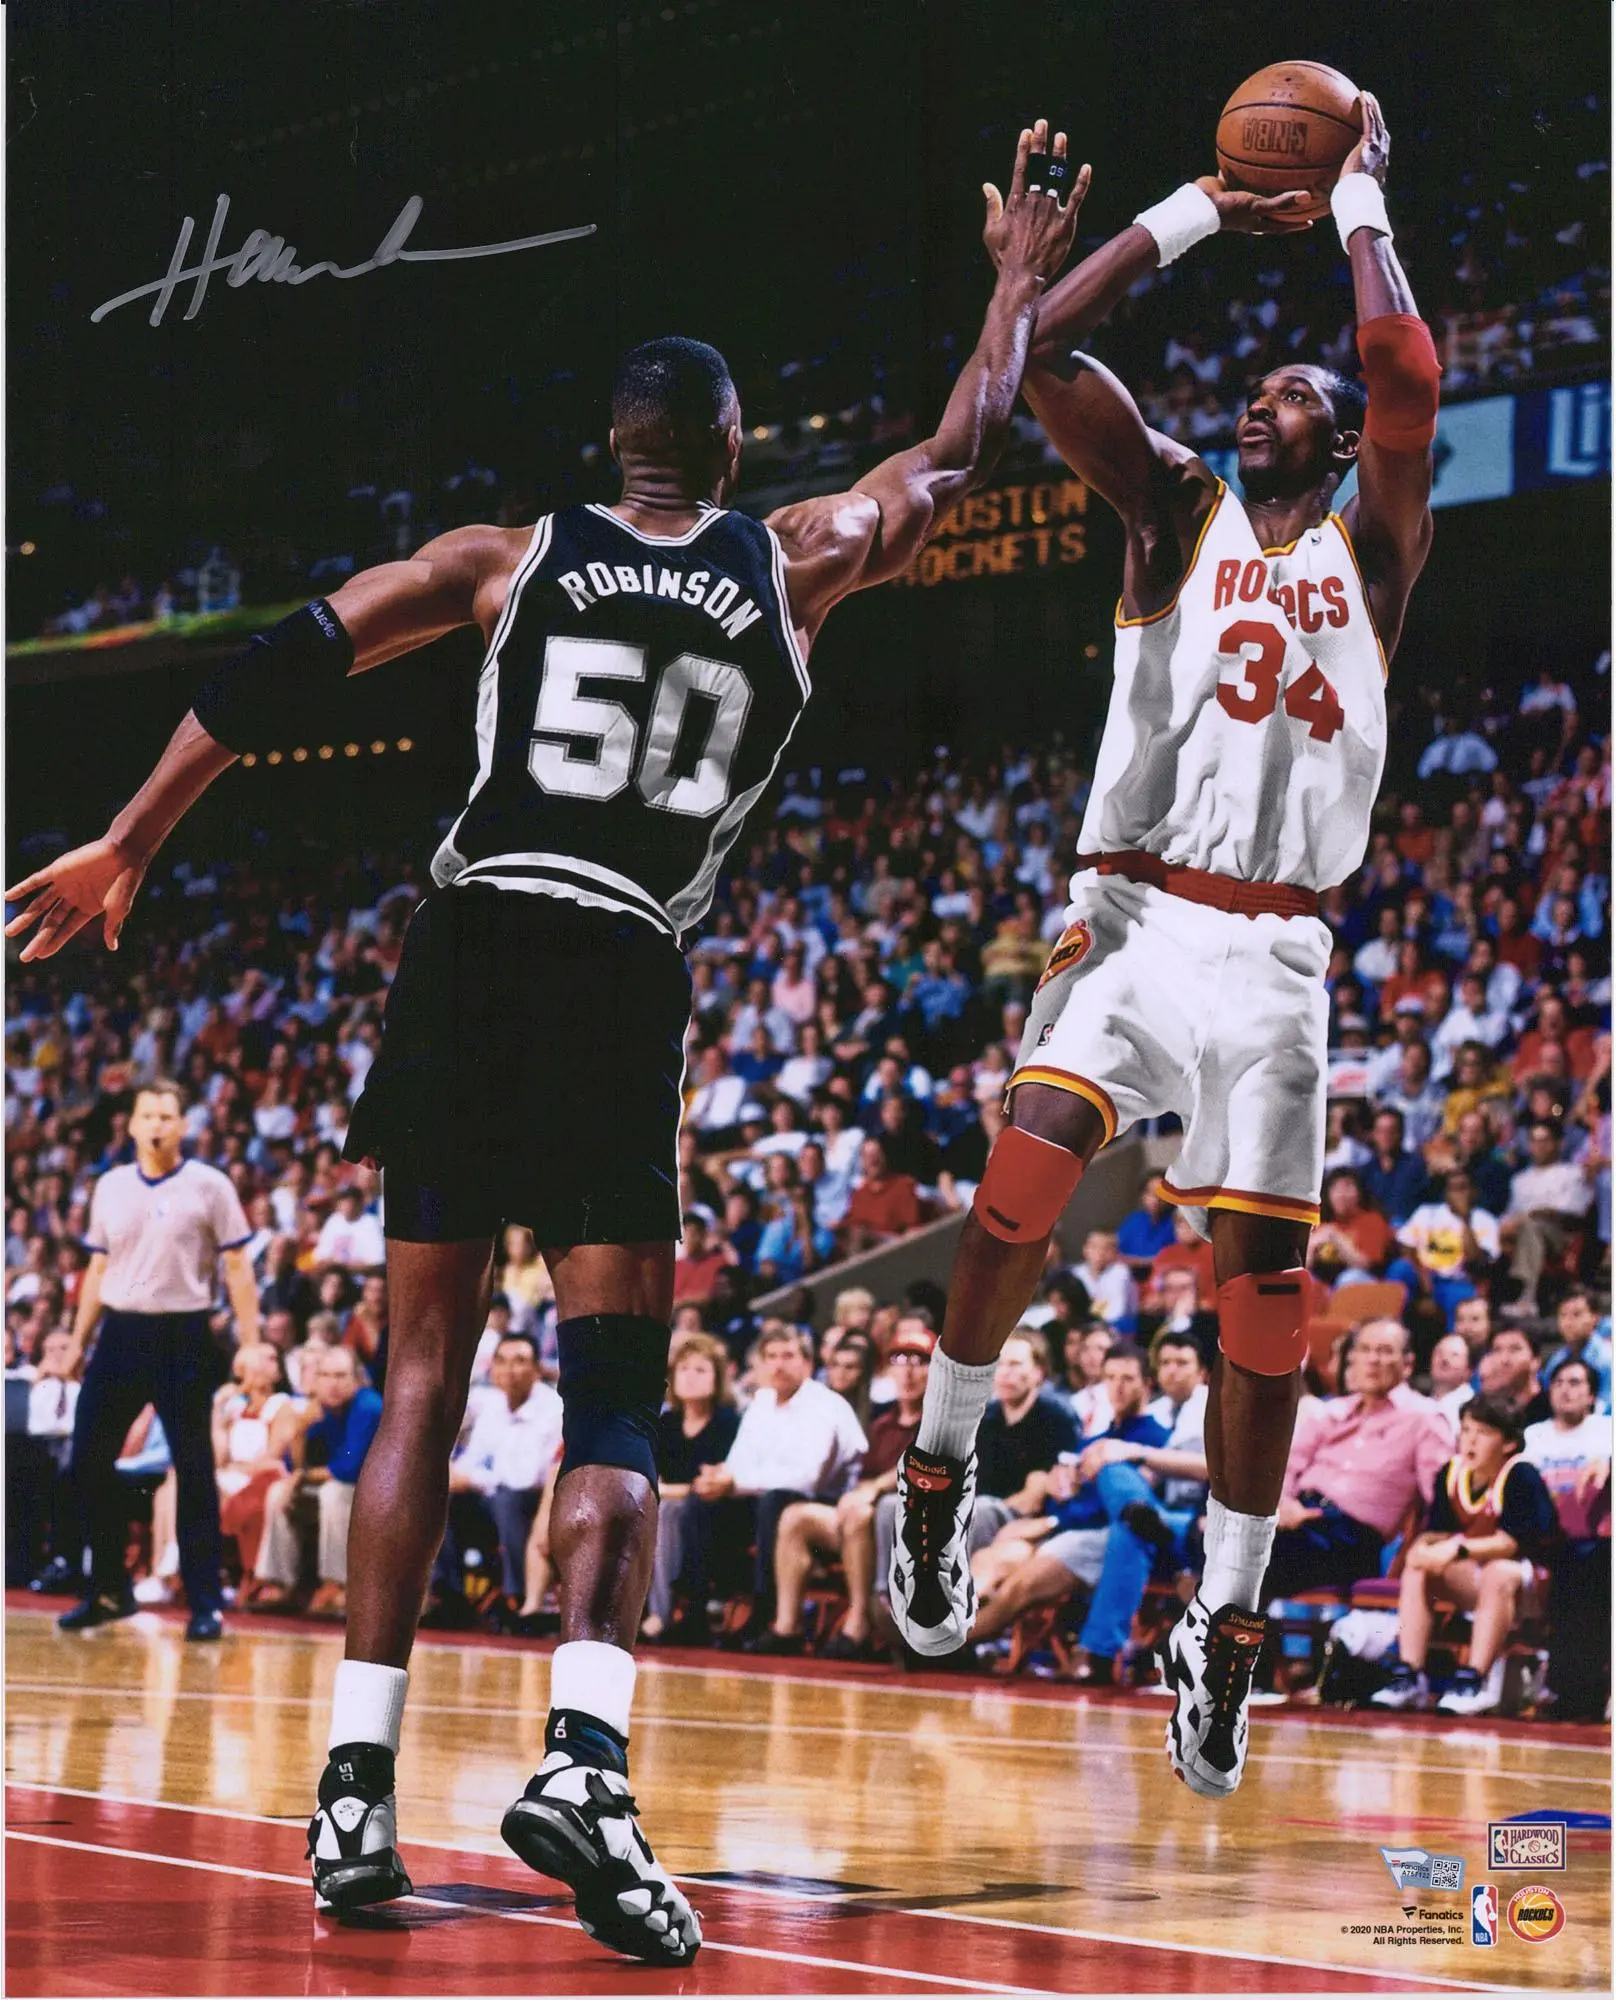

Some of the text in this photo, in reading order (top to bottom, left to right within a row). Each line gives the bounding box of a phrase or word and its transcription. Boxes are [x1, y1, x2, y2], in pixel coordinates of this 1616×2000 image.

[1550, 383, 1612, 477] Li
[557, 561, 762, 640] ROBINSON
[527, 634, 754, 819] 50
[1216, 619, 1345, 744] 34
